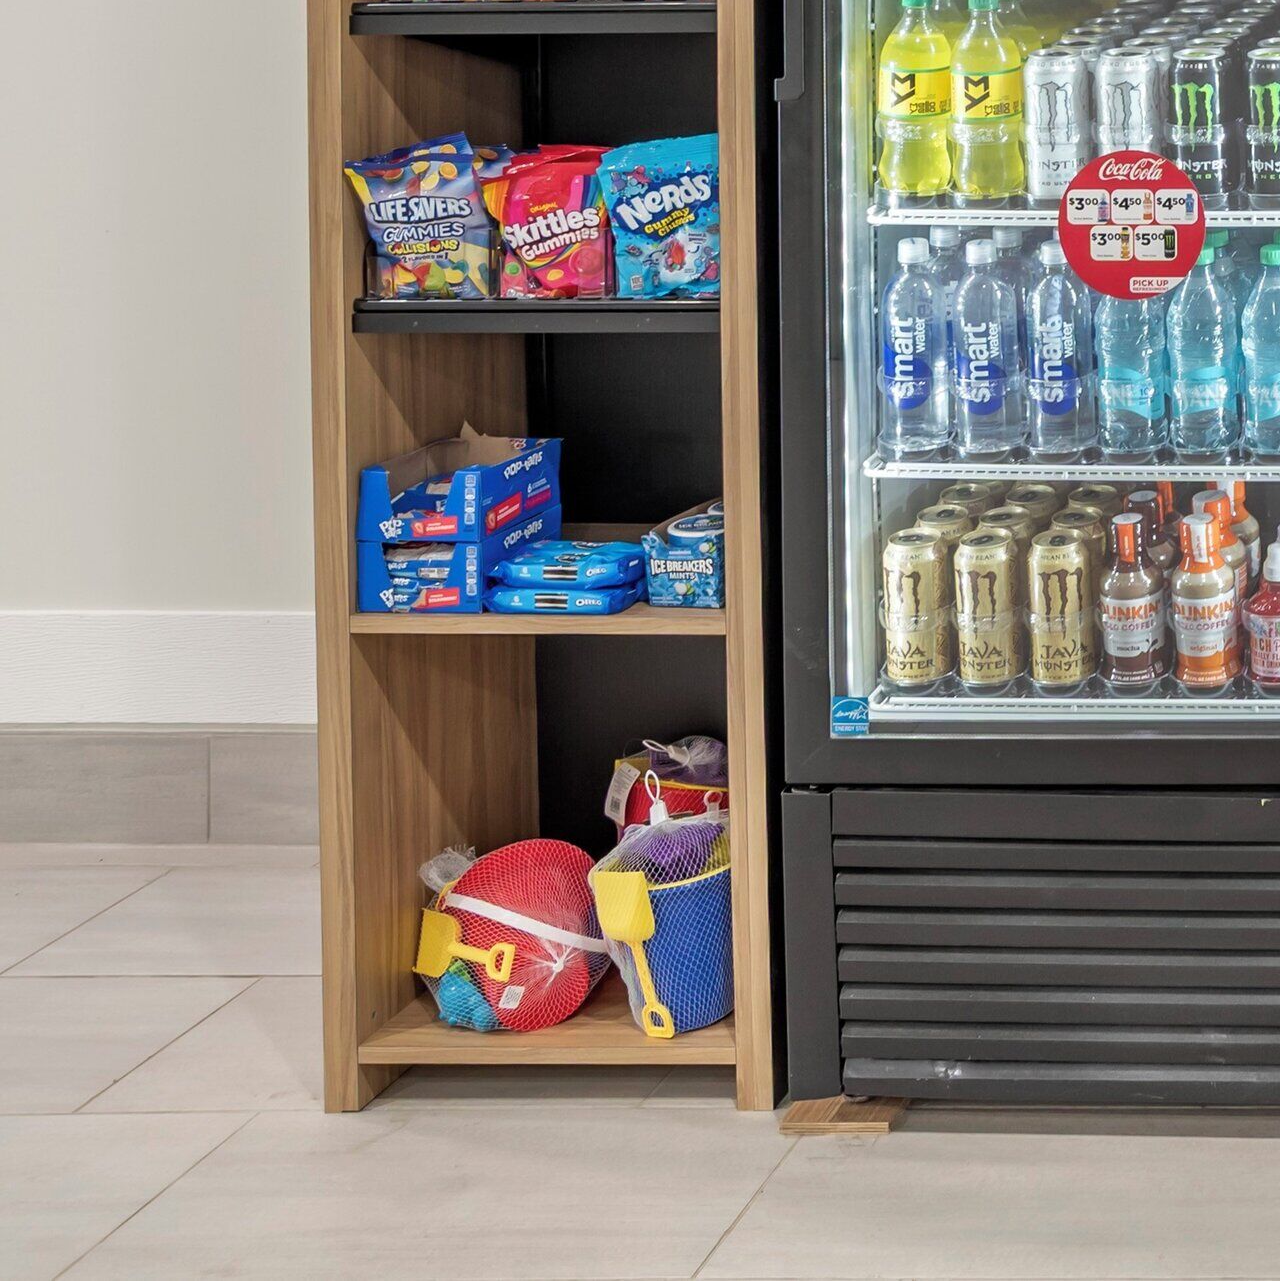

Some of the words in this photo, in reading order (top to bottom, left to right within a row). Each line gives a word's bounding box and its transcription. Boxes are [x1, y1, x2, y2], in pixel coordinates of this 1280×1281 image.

[1098, 158, 1166, 181] Coca-Cola
[370, 198, 409, 222] LIFE
[408, 196, 472, 221] SAVERS
[643, 206, 690, 234] Gummy
[383, 222, 465, 243] GUMMIES
[502, 206, 600, 249] Skittles
[387, 239, 460, 255] COLLISIONS
[521, 227, 599, 262] Gummies
[1132, 279, 1154, 287] PICK
[1156, 279, 1169, 287] UP
[914, 317, 926, 354] water
[989, 322, 1001, 358] water
[1063, 322, 1074, 359] water
[892, 317, 915, 399] smart
[968, 322, 990, 403] smart
[1042, 322, 1063, 403] smart
[650, 558, 667, 575] ICE
[667, 558, 714, 575] BREAKERS
[669, 572, 696, 580] MINTS
[960, 640, 1003, 659] JAVA
[1040, 639, 1089, 659] JAVA
[1034, 655, 1094, 671] MONSTER
